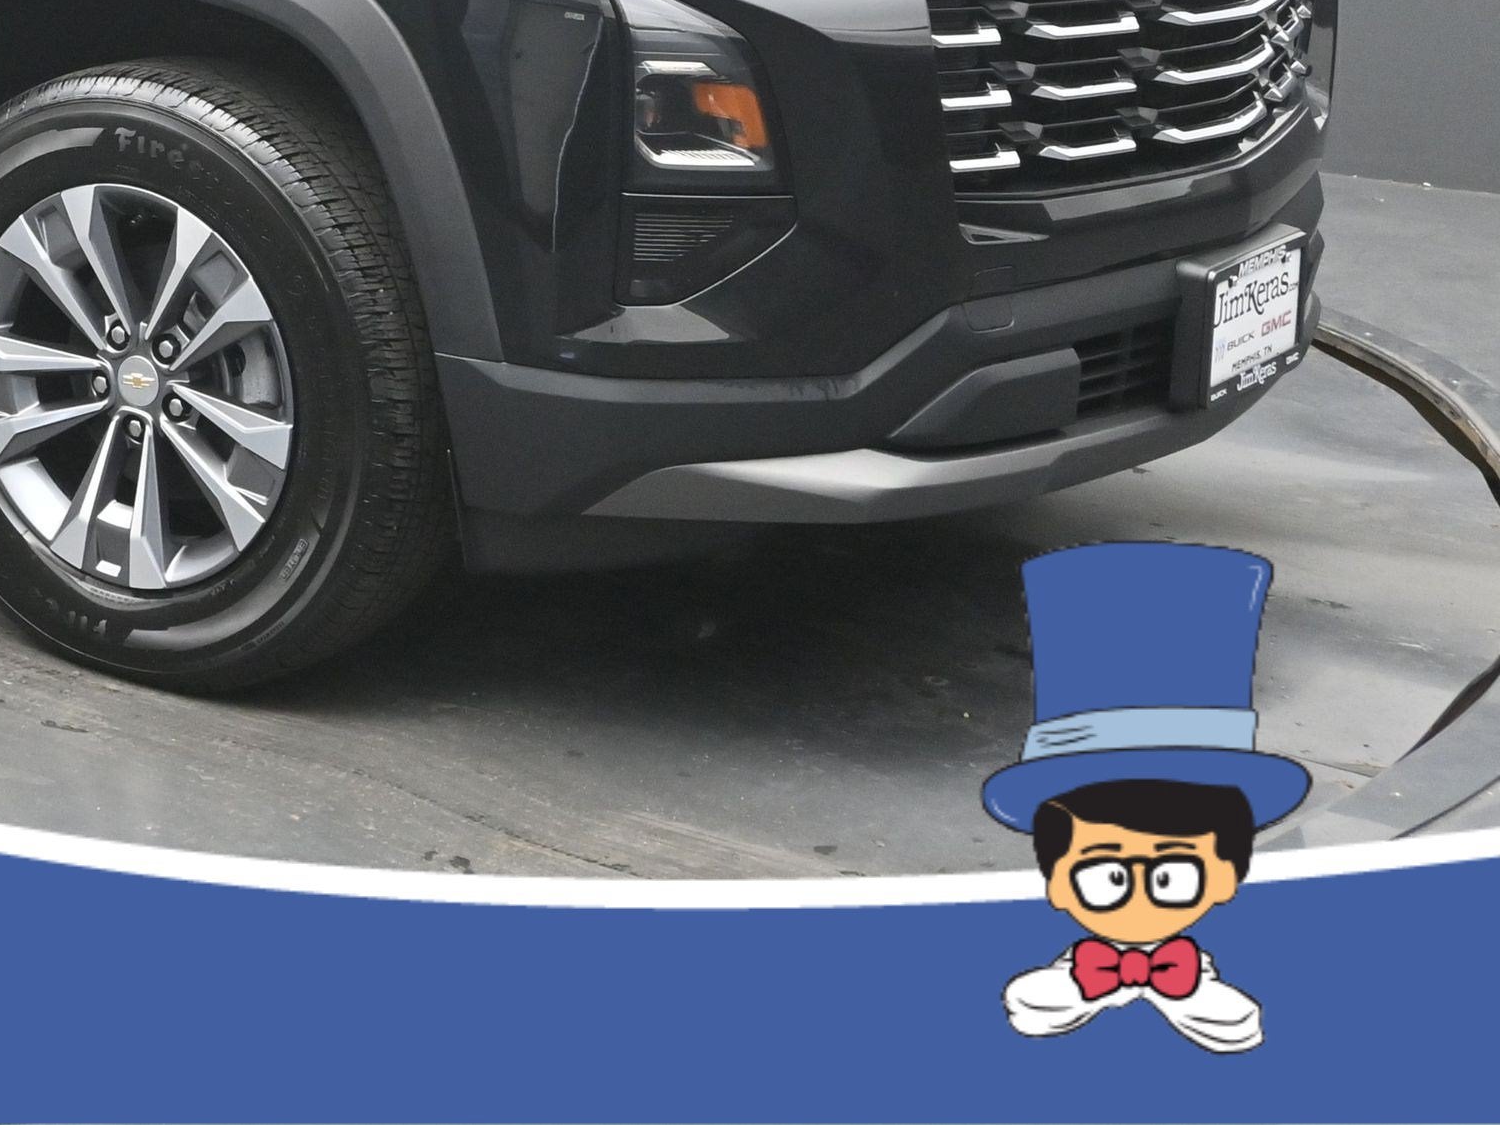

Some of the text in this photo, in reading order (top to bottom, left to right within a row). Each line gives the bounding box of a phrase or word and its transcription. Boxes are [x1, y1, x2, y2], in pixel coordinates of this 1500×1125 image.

[1238, 244, 1287, 278] MEMPHIS
[1227, 310, 1292, 352] BUICK GMC
